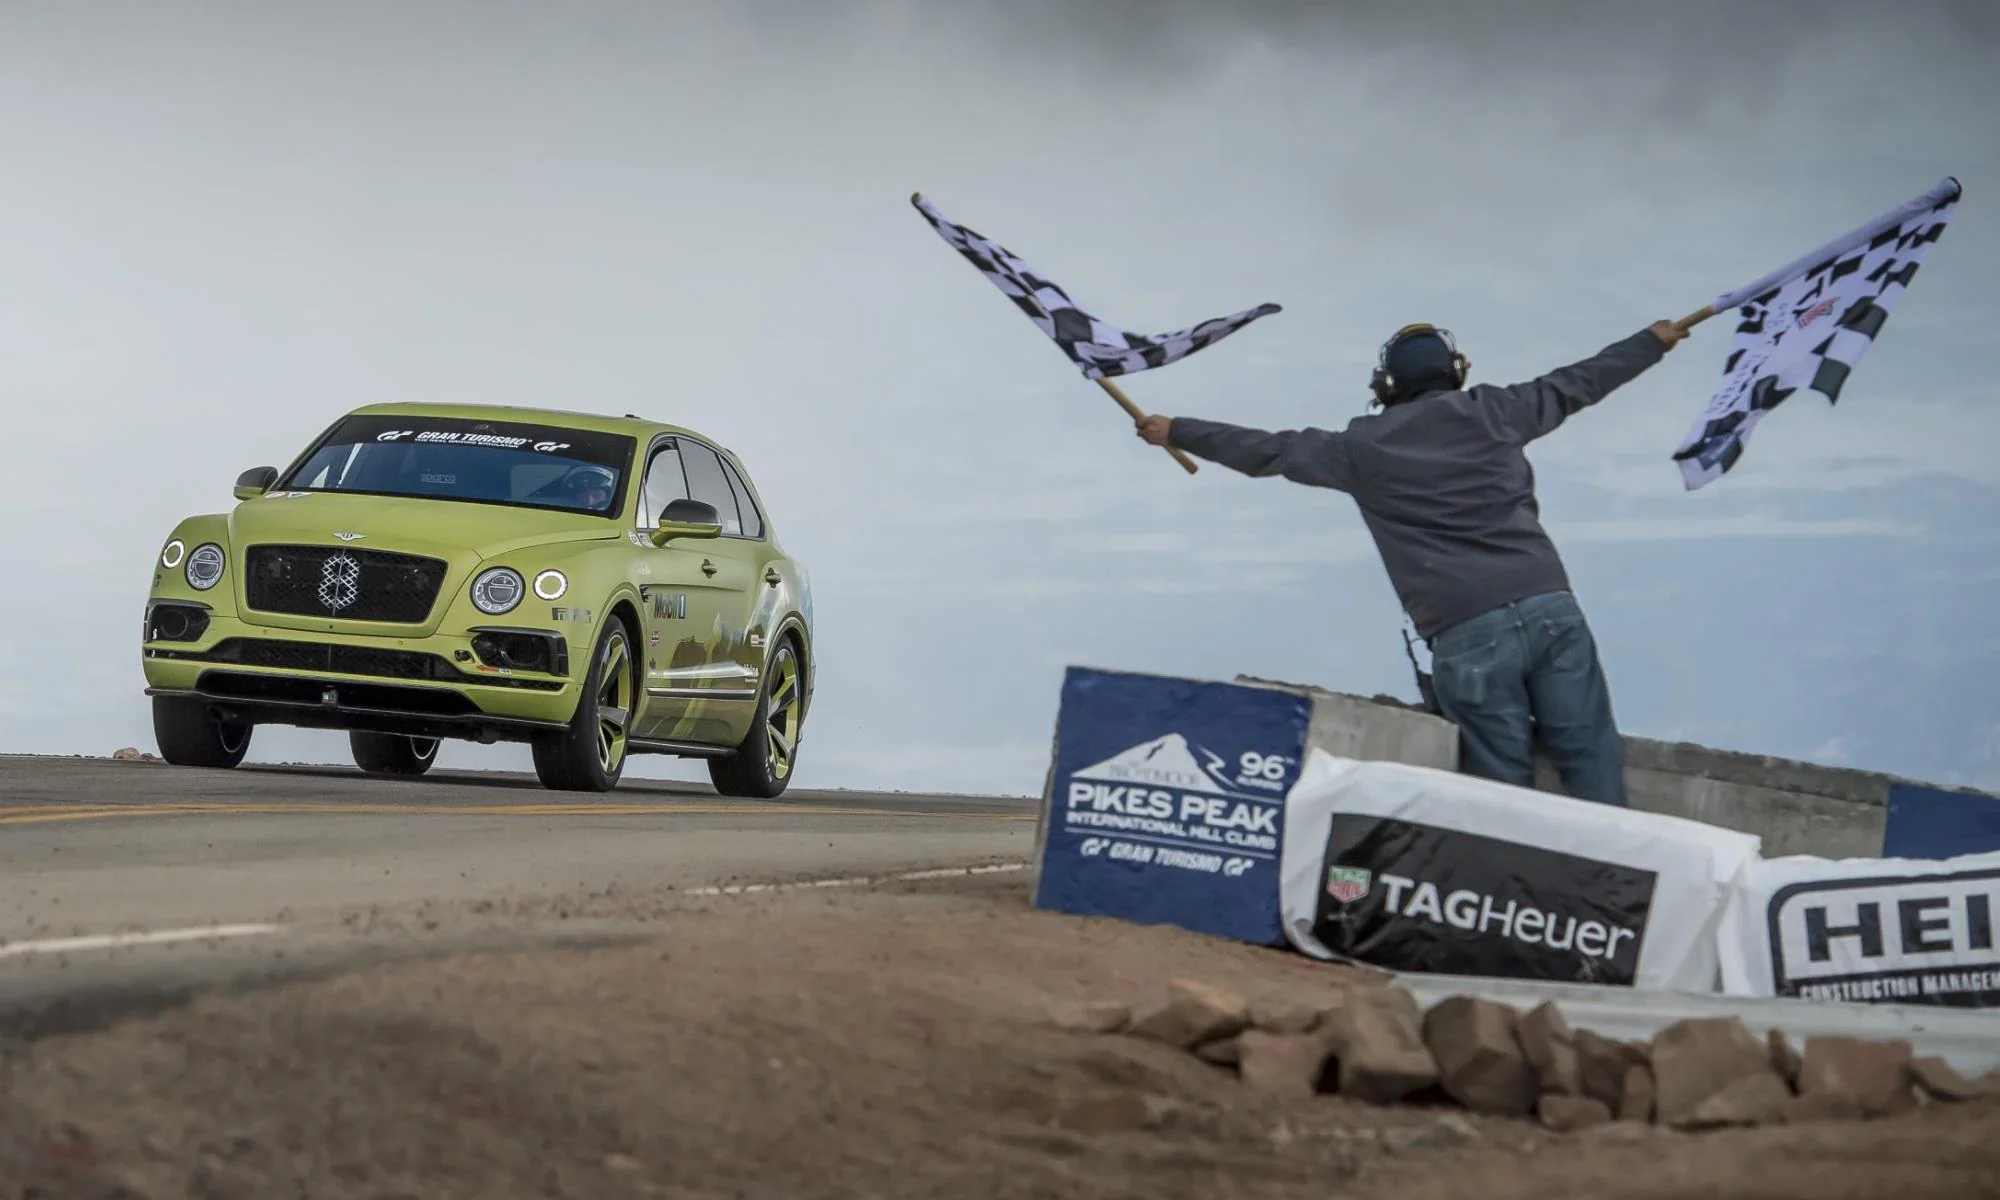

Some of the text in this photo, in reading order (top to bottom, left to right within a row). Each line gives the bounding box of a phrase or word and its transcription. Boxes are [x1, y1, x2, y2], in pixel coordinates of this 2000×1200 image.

[416, 431, 461, 440] GRAN
[461, 433, 527, 445] TURISMO
[419, 473, 456, 483] sparco
[1067, 782, 1278, 834] PIKES PEAK
[1066, 811, 1277, 850] INTERNATIONAL HILL CLIMB
[1108, 841, 1154, 863] GRAN
[1154, 848, 1222, 873] TURISMO
[1803, 893, 1994, 963] HEI
[1799, 976, 1919, 1002] CONSTRUCTION
